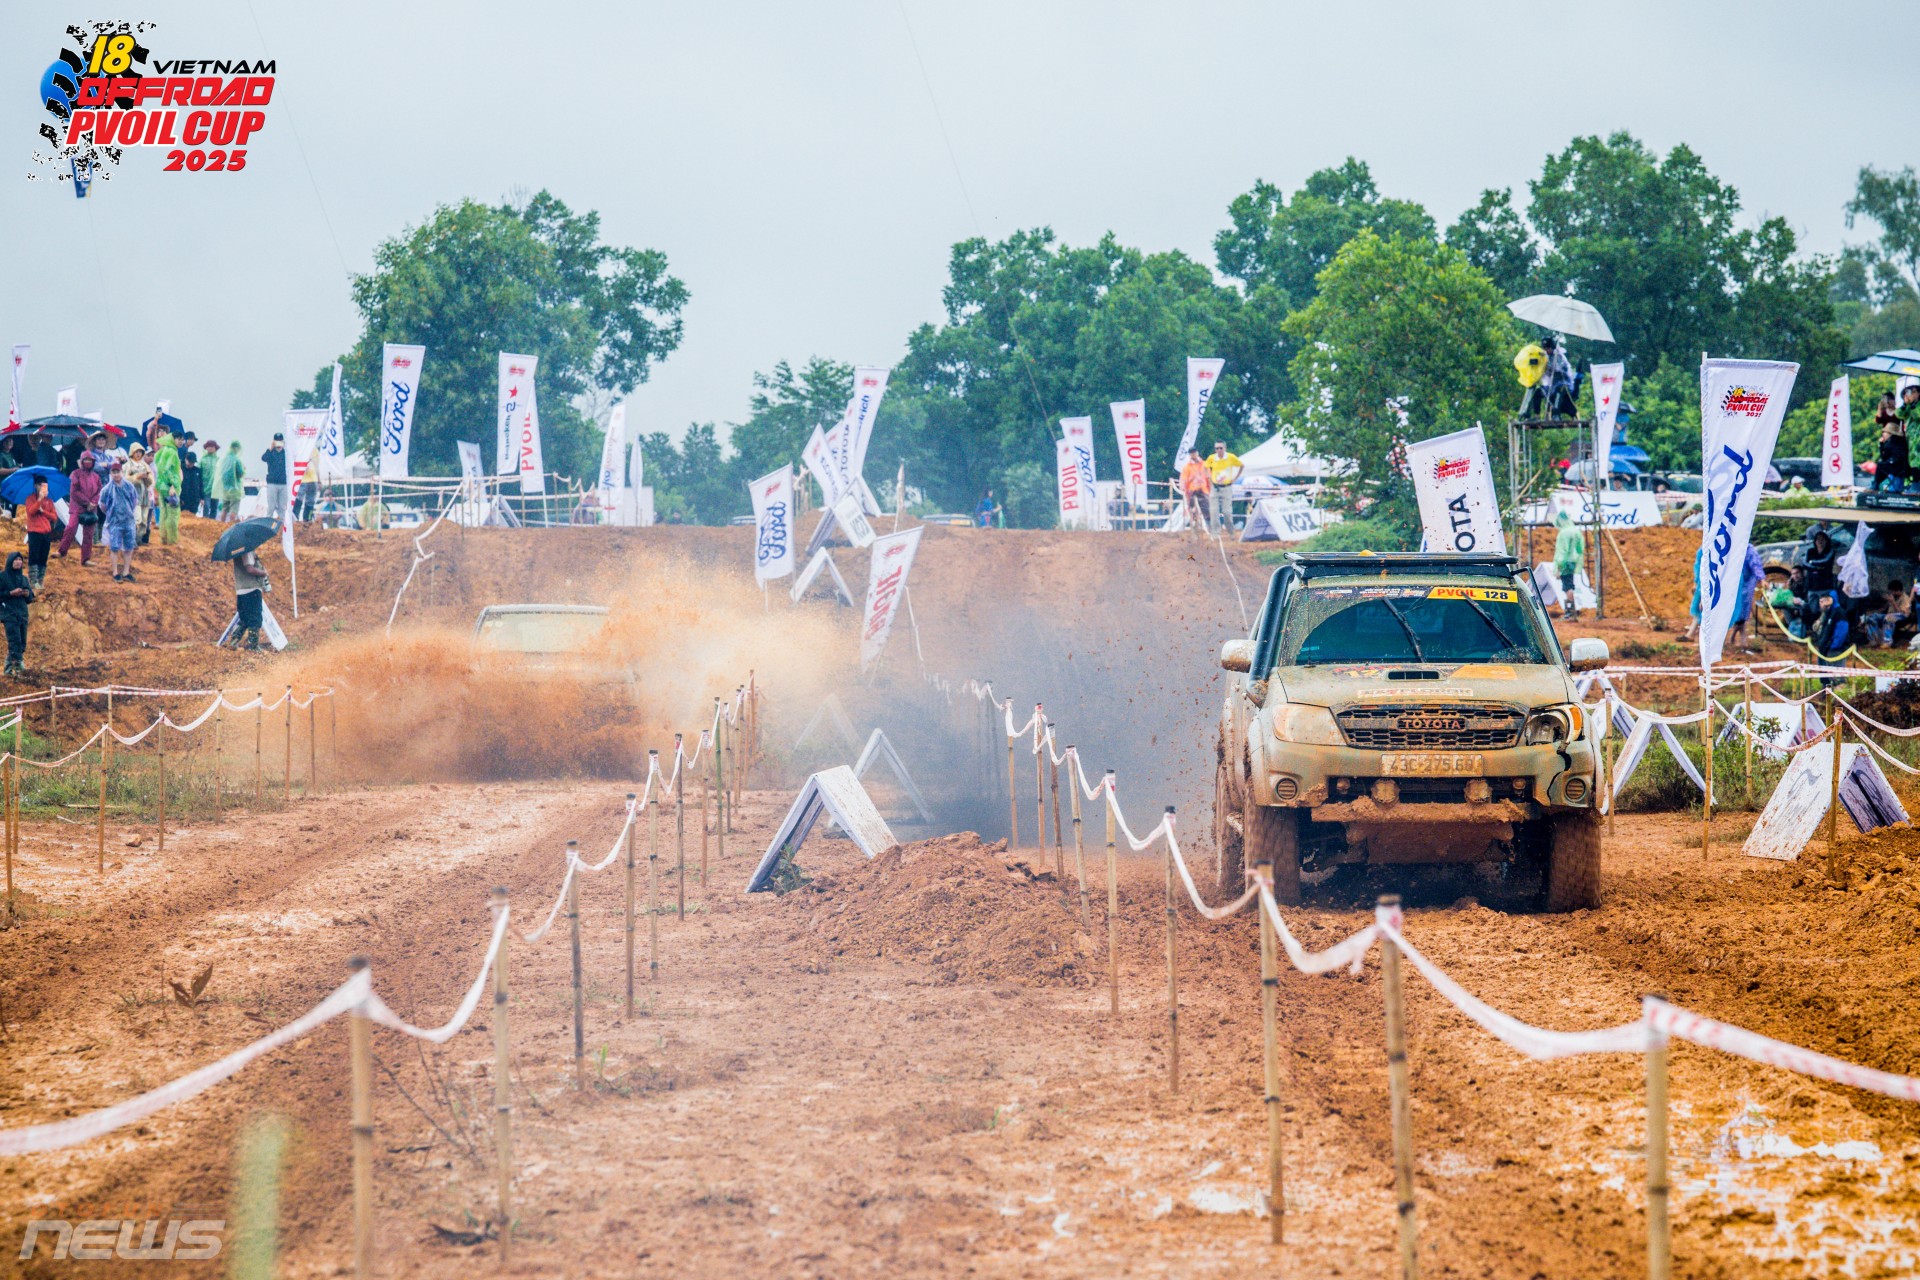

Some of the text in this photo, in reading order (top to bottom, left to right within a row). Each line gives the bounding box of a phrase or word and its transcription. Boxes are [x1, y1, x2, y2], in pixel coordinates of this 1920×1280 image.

[383, 381, 411, 455] Ford
[1750, 403, 1765, 412] CU
[1124, 431, 1144, 485] PVOIL
[1448, 493, 1476, 552] OTA
[1483, 591, 1508, 599] 128
[1402, 719, 1460, 729] TOYOTA
